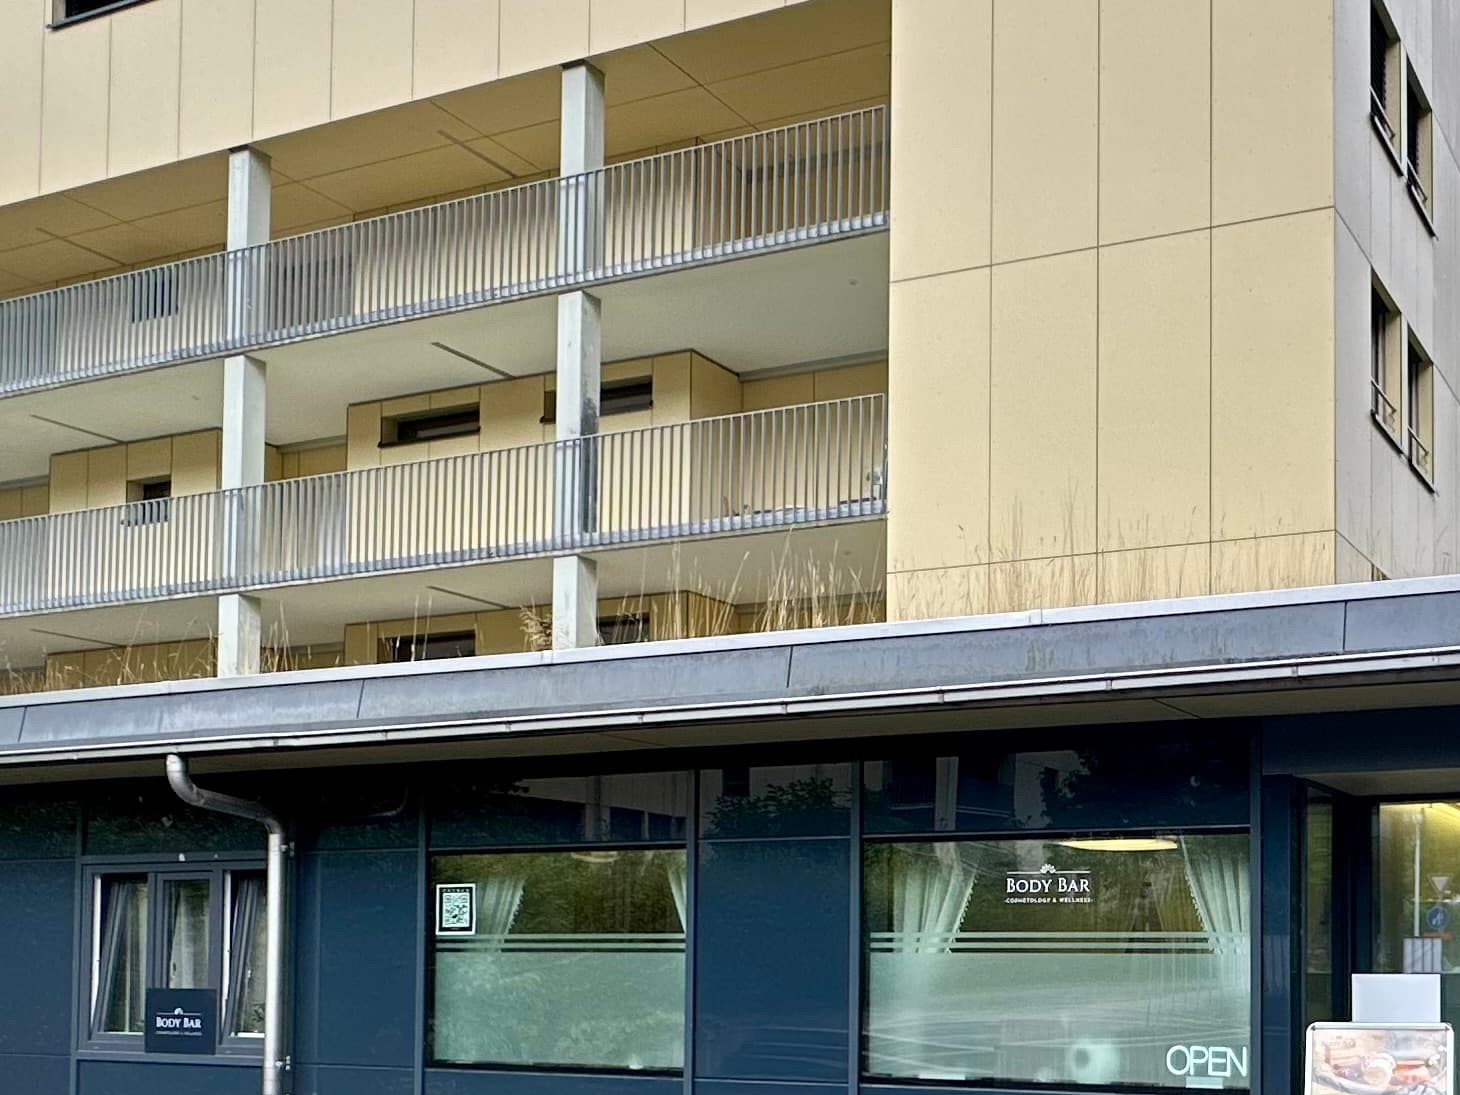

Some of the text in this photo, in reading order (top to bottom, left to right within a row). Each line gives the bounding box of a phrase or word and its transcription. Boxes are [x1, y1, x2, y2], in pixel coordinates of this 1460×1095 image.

[1006, 877, 1090, 893] BODY BAR
[155, 1016, 202, 1028] BODY BAR
[1166, 1045, 1247, 1078] OPEN
